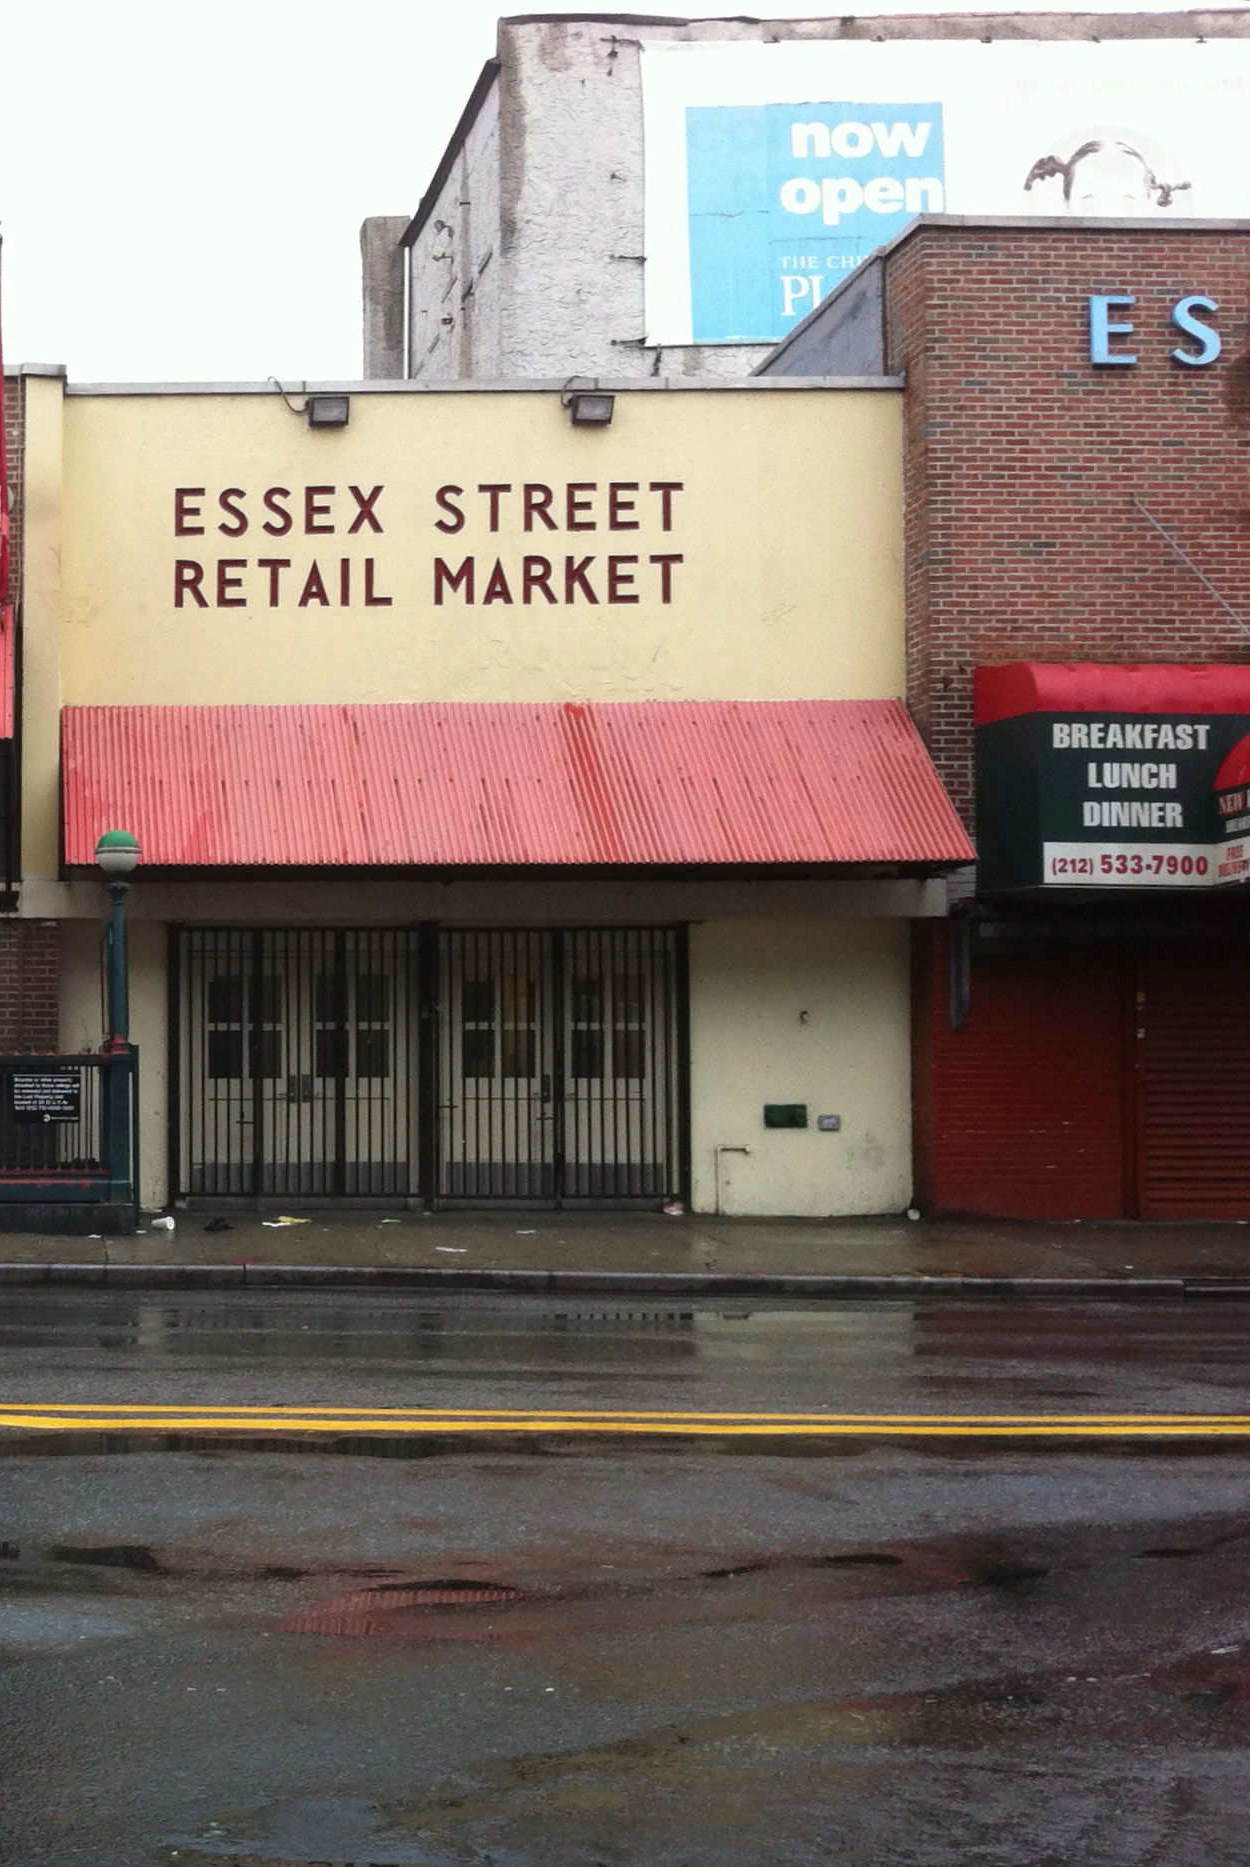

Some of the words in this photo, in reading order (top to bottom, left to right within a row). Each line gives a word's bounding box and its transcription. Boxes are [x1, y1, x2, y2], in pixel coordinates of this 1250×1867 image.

[790, 121, 932, 158] now
[780, 177, 944, 226] open
[779, 255, 819, 269] THE
[174, 485, 385, 537] ESSEX
[434, 482, 684, 534] STREET
[174, 557, 393, 608] RETAIL
[434, 553, 684, 605] MARKET
[1052, 723, 1210, 750] BREAKFAST
[1088, 762, 1177, 789] LUNCH
[1083, 801, 1184, 828] DINNER
[1051, 857, 1094, 876] (212)
[1100, 855, 1208, 876] 533-7900
